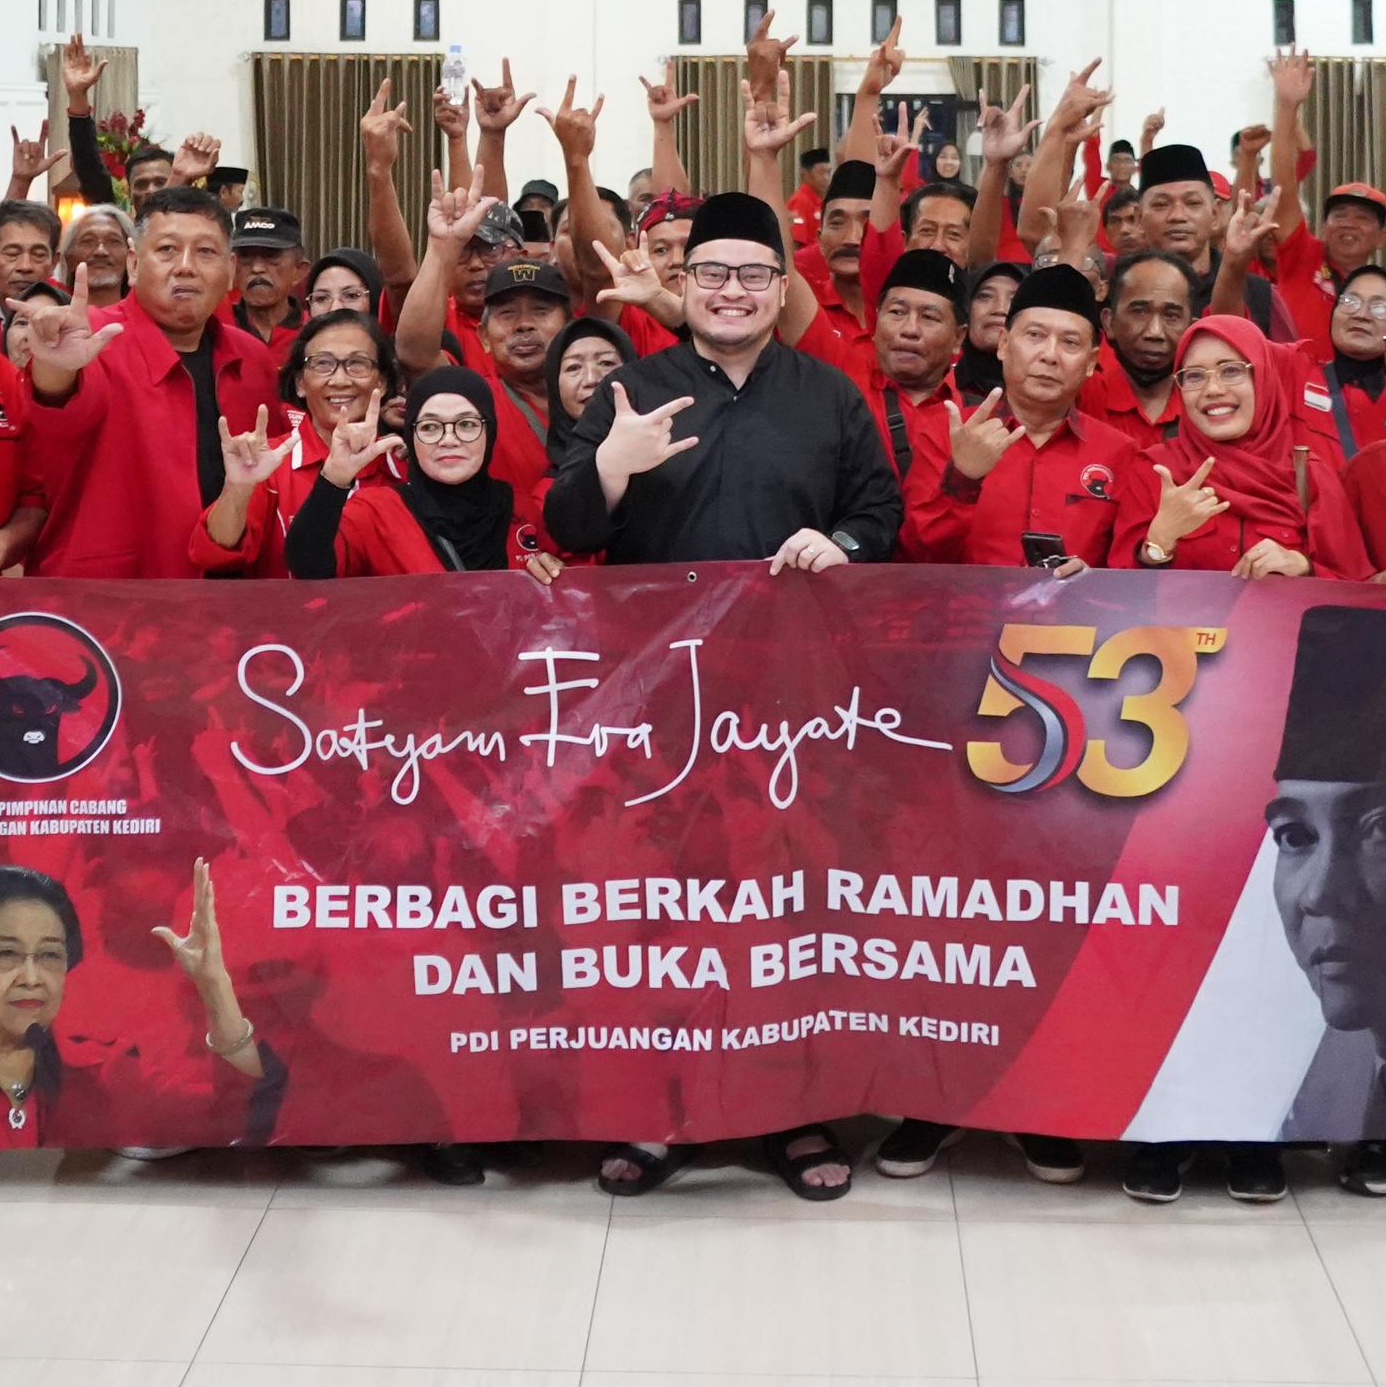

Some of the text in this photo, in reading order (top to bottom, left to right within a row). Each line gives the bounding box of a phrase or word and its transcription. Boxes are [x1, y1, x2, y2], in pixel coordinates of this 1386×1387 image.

[230, 644, 506, 805] Satyam
[624, 639, 953, 809] Jayate
[29, 819, 110, 835] KABUPATEN
[112, 818, 161, 834] KEDIRI
[69, 799, 127, 815] CABANG
[273, 868, 1180, 929] BERBAGI BERKAH RAMADHAN
[413, 932, 1037, 995] DAN BUKA BERSAMA
[450, 1009, 1000, 1053] PDI PERJUANGAN KABUPATEN KEDIRI
